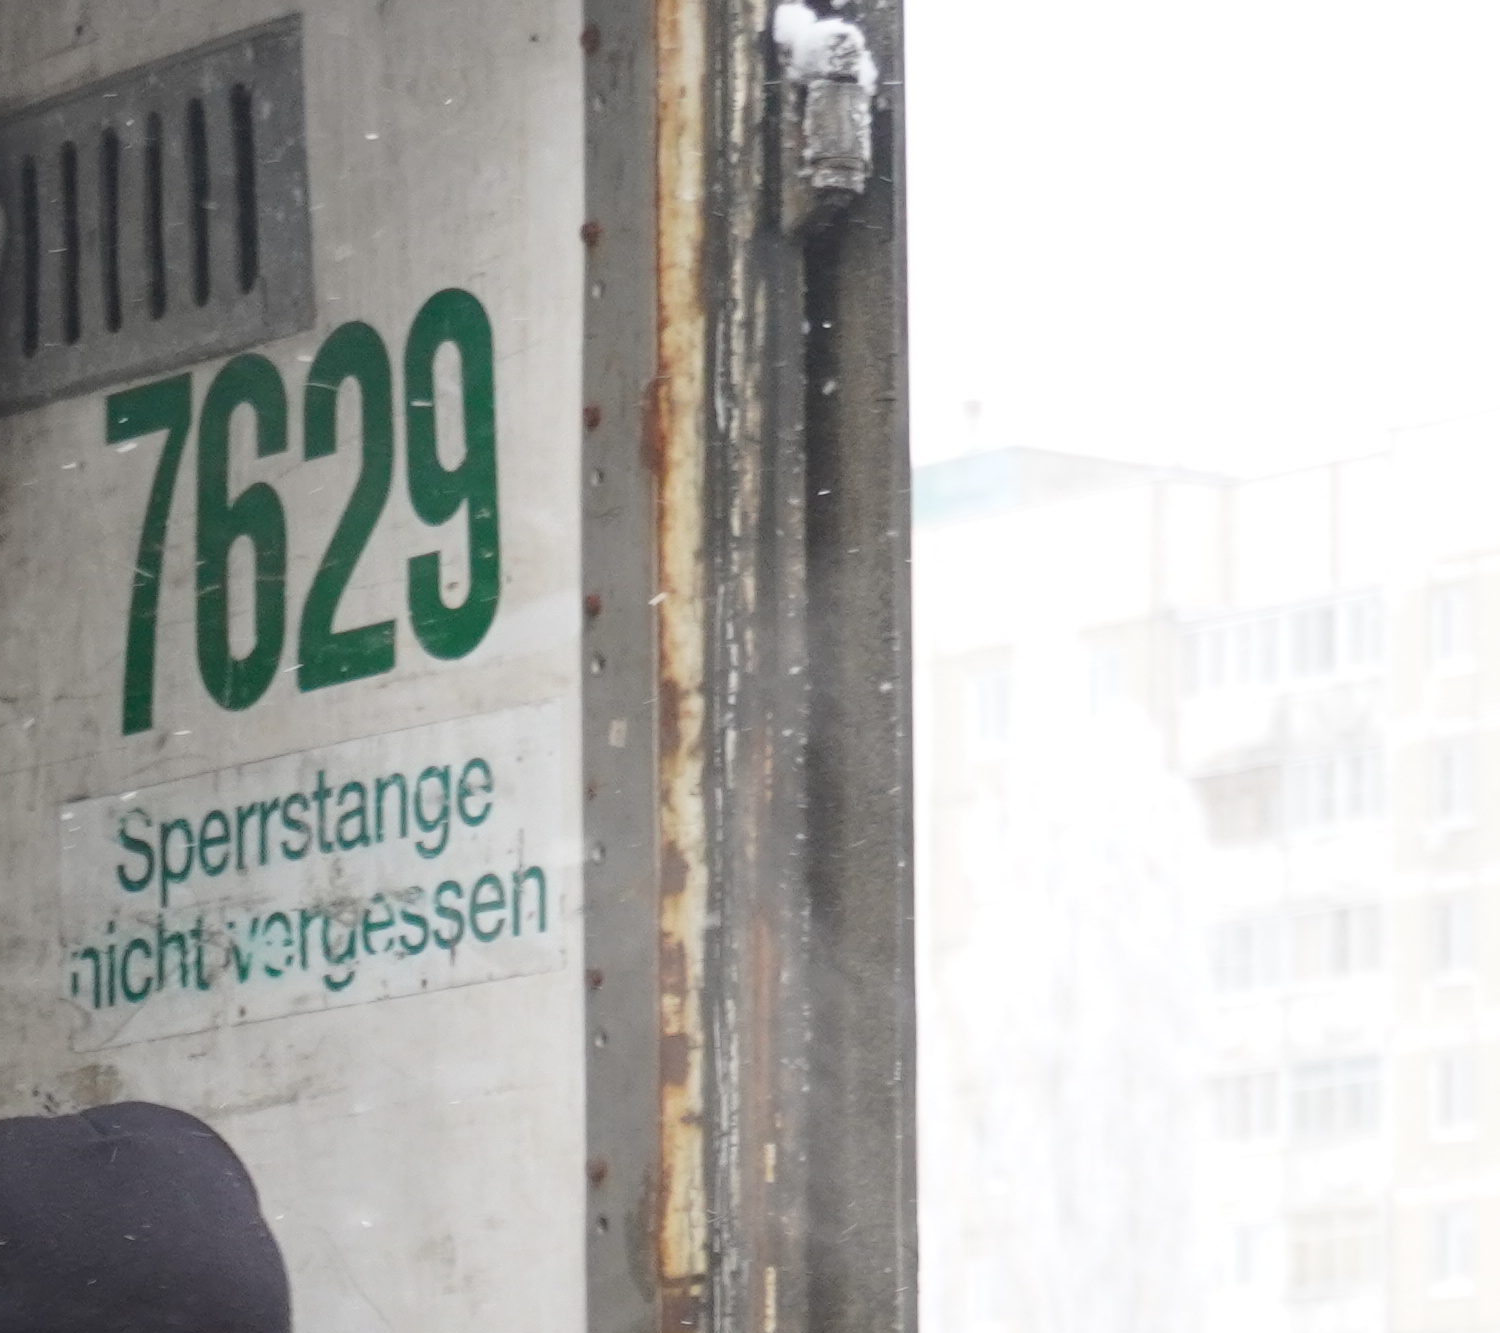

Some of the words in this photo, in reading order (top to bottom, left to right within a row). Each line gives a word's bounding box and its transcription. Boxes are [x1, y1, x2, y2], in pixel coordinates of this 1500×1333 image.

[105, 288, 501, 736] 7629
[116, 757, 494, 908] Sperrstange
[70, 912, 213, 1010] nicht
[226, 865, 548, 991] vergessen
